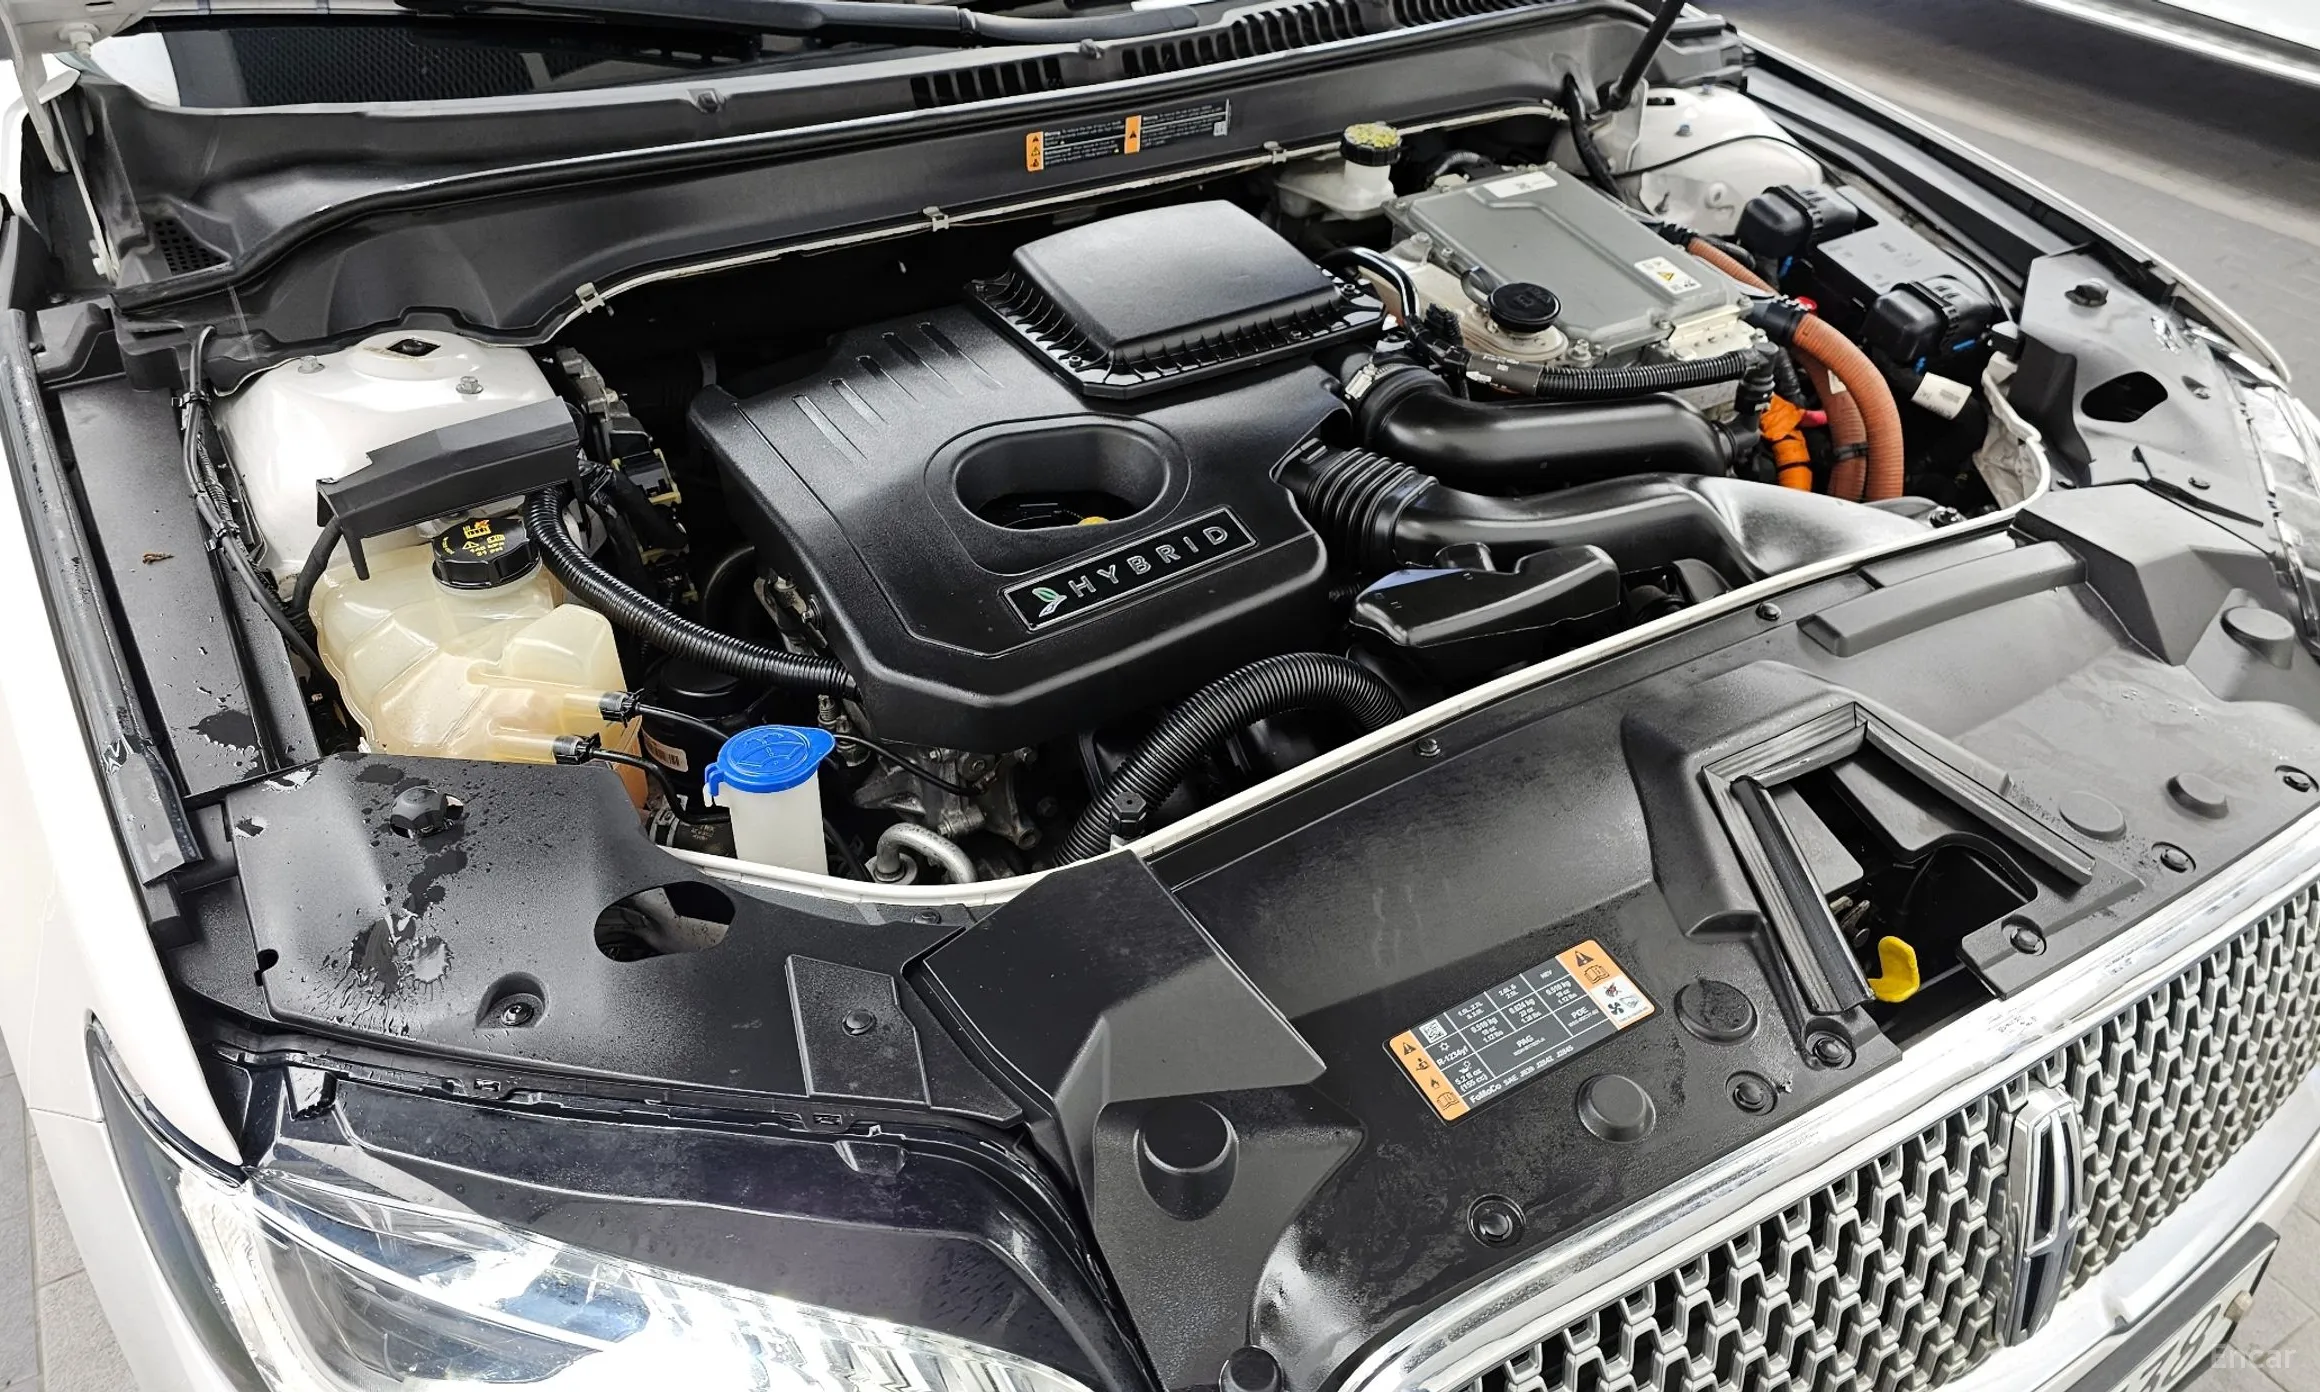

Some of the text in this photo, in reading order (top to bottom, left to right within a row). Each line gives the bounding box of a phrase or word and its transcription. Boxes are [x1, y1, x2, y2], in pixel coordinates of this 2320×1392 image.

[1067, 525, 1229, 598] HYBRID
[1570, 1006, 1589, 1019] POE
[1516, 1034, 1534, 1048] PAG
[1436, 1045, 1468, 1066] R-1234yf
[1469, 1083, 1502, 1103] FoMoCo
[1502, 1073, 1519, 1086] SAE
[2120, 1303, 2222, 1392] 38
